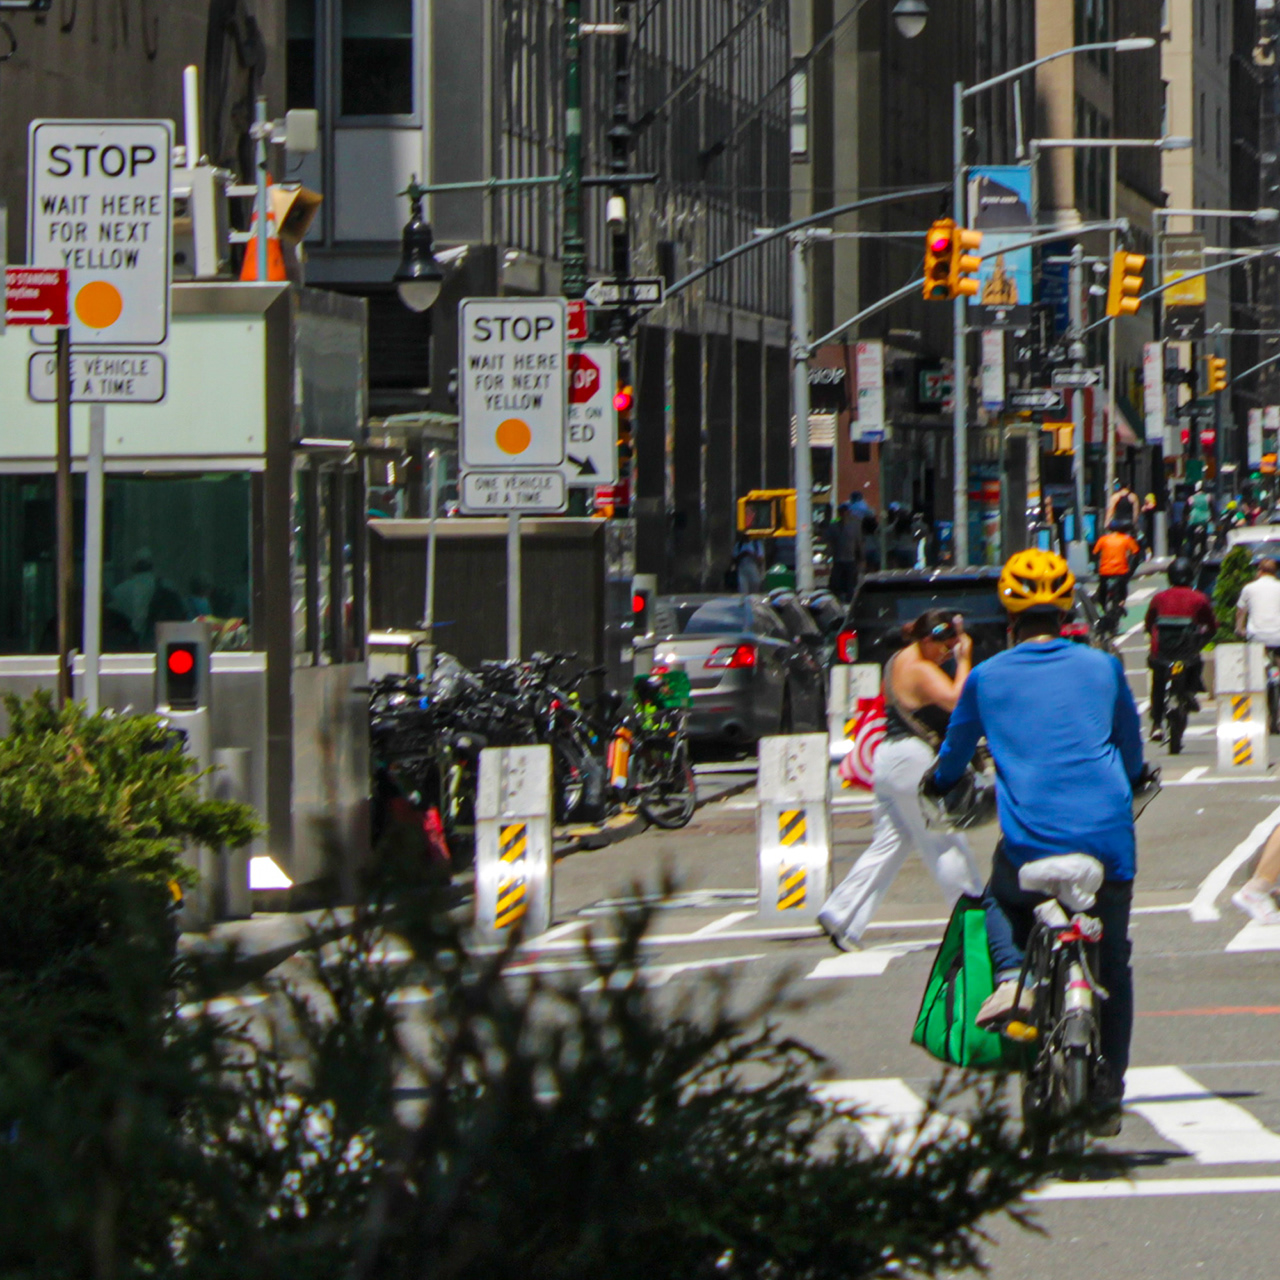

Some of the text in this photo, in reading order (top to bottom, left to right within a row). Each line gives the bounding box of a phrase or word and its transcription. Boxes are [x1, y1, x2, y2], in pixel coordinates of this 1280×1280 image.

[47, 144, 156, 177] STOP
[41, 194, 161, 216] WAIT HERE
[50, 222, 150, 242] FOR NEXT
[61, 248, 140, 269] YELLOW
[473, 317, 554, 342] STOP
[45, 359, 149, 376] OE VEHICLE
[469, 353, 559, 369] WAIT HERE
[83, 379, 93, 394] A
[100, 379, 135, 395] TIME
[475, 374, 551, 390] FOR NEXT
[485, 394, 543, 410] YELLOW
[568, 425, 595, 442] ED
[475, 477, 552, 490] ONE VEHICLE
[486, 492, 541, 504] AT A TIME
